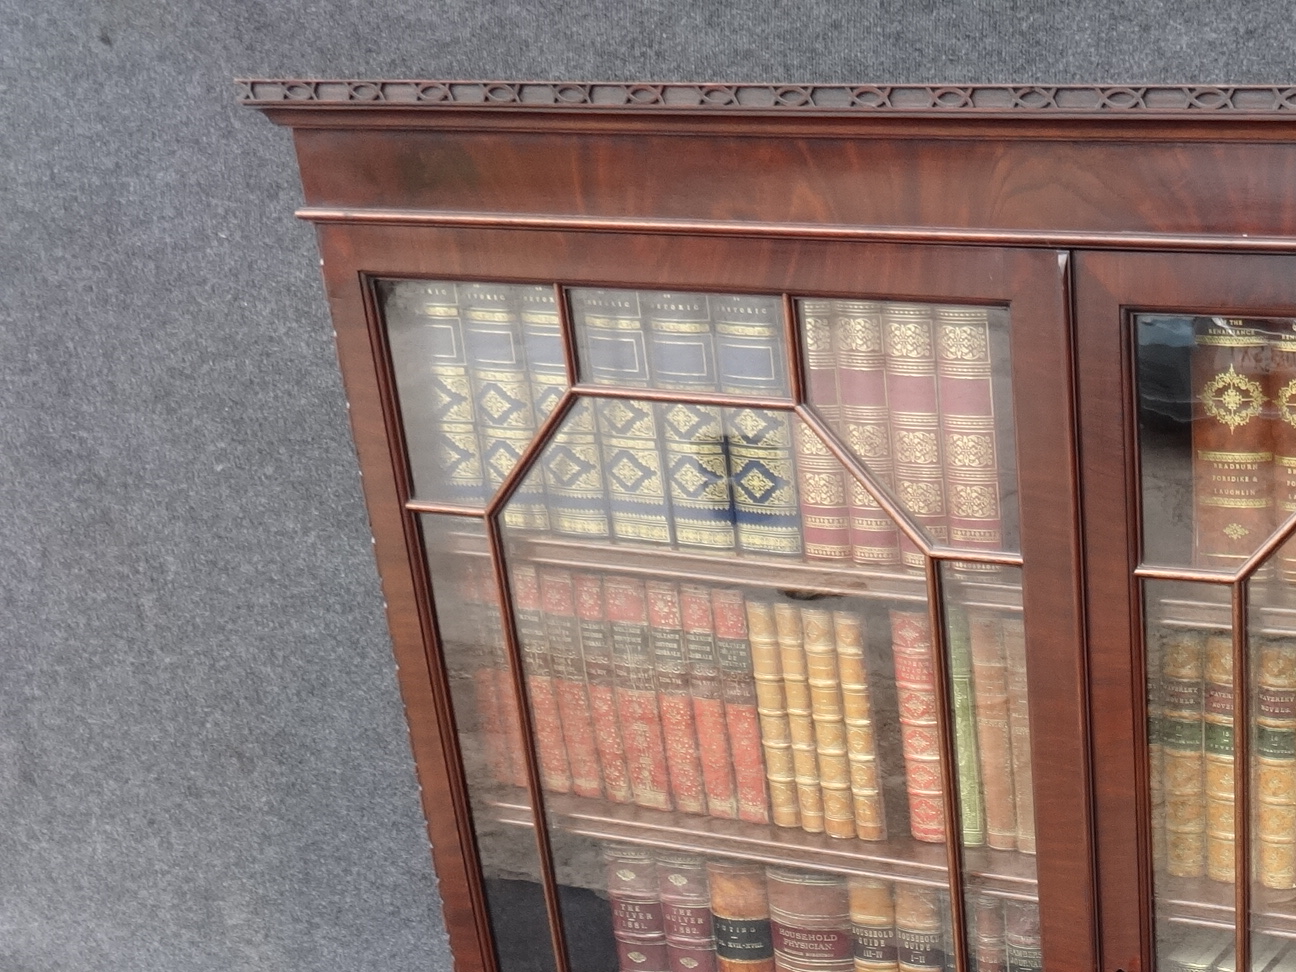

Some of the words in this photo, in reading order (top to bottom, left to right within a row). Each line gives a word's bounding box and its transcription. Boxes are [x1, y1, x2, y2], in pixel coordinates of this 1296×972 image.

[1213, 463, 1258, 471] BRADBURN
[1212, 475, 1249, 483] FORSDIKE
[1214, 488, 1256, 496] LAUGHLIN
[620, 903, 641, 912] THE
[672, 908, 692, 916] THE
[665, 913, 704, 924] QUIVER
[779, 927, 839, 942] HOUSEHOLD
[783, 937, 835, 951] PHYSICIAN.
[858, 937, 886, 947] GUIDE
[904, 941, 931, 952] GUIDE
